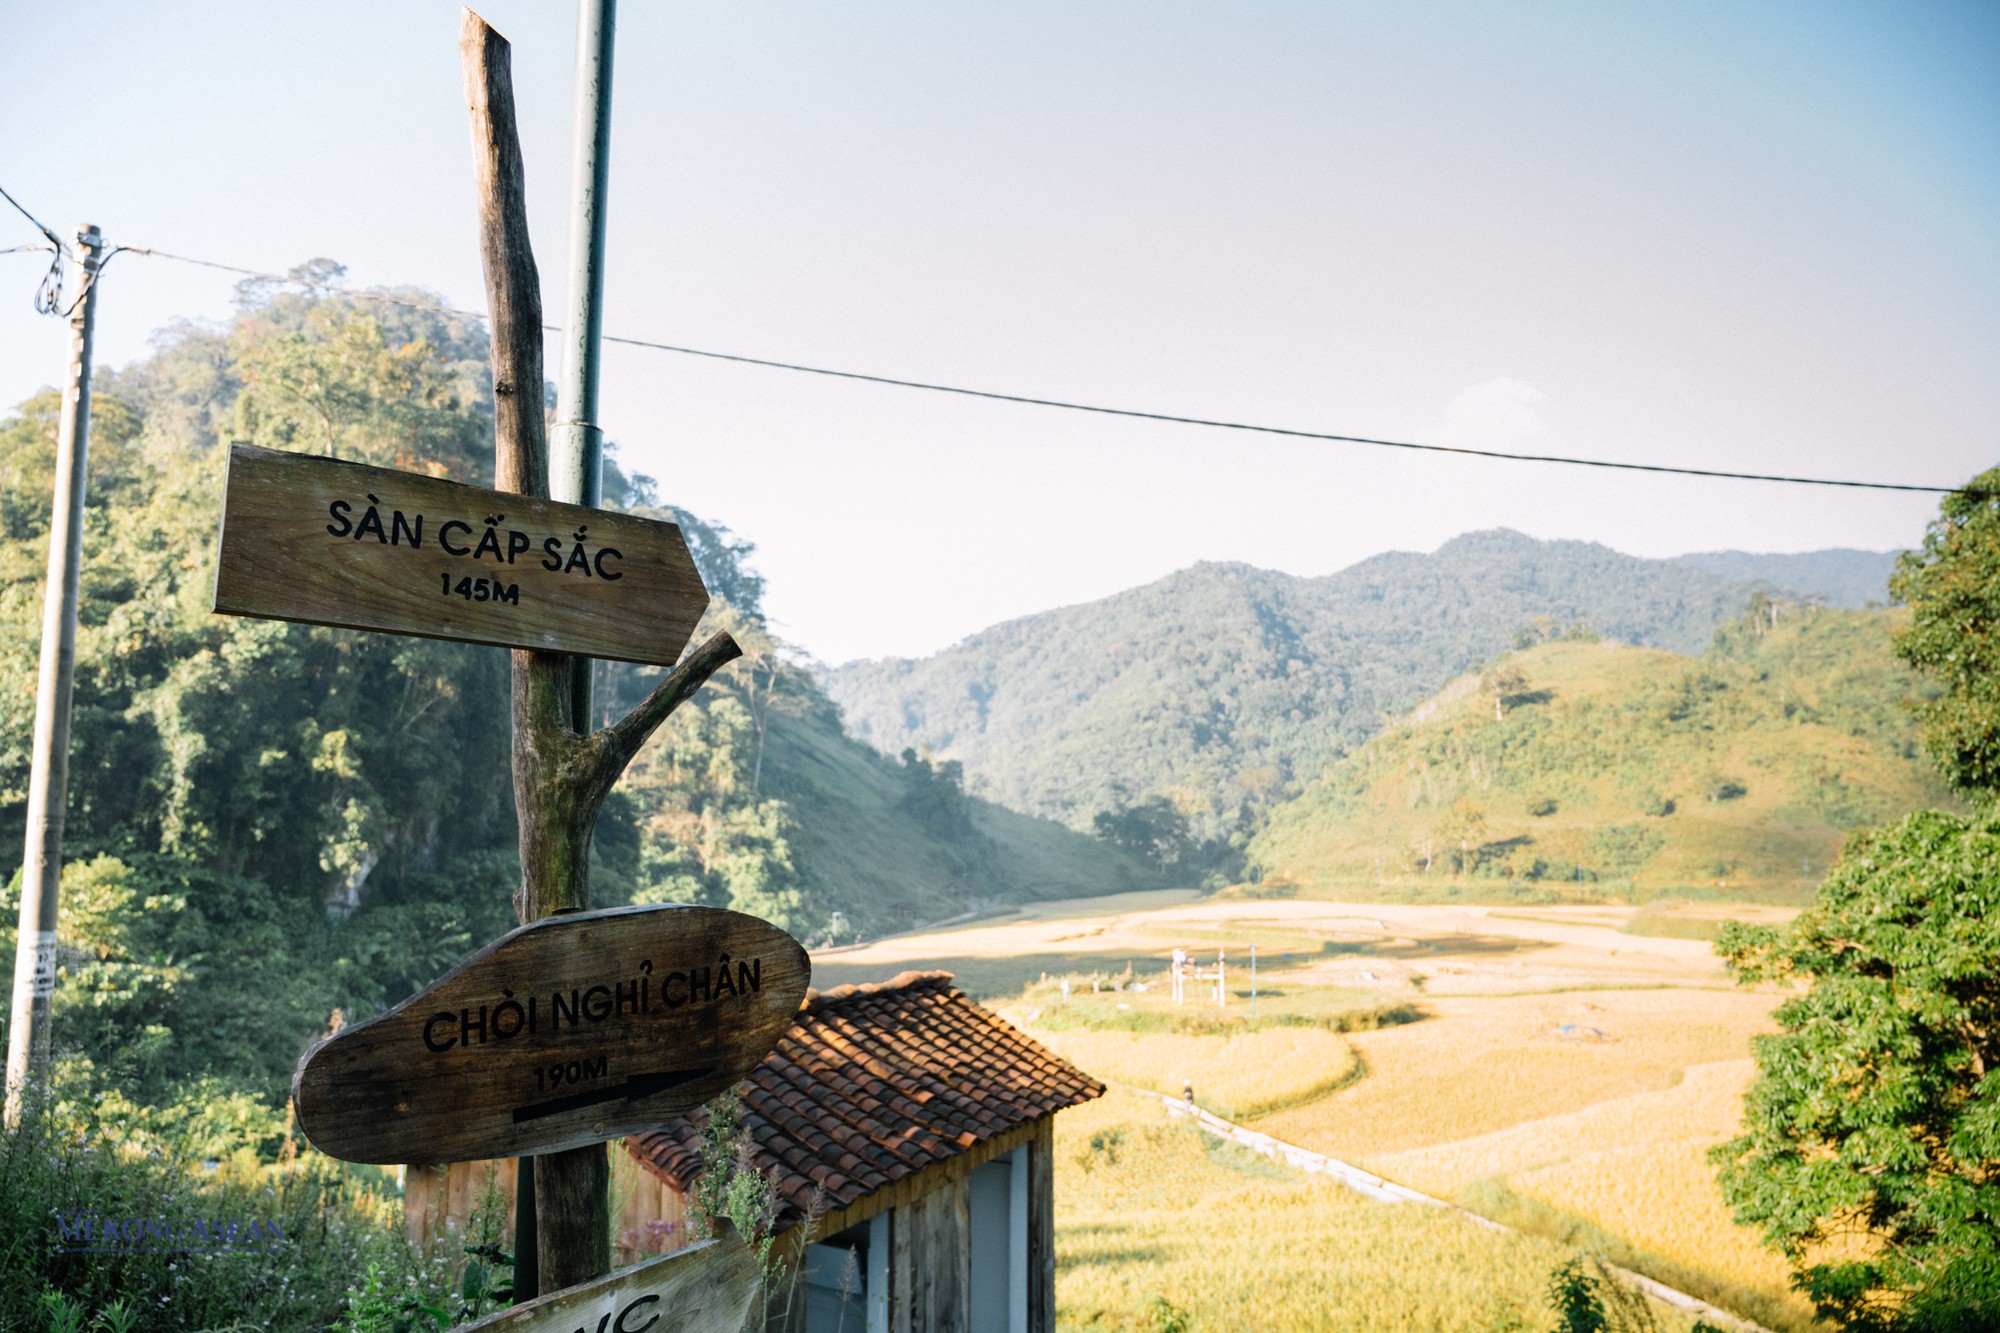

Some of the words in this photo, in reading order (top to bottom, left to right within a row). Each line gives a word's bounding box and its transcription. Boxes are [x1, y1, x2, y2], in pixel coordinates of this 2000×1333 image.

[326, 493, 423, 549] SÀN
[438, 513, 531, 565] CẤP
[541, 525, 623, 581] SẮC
[441, 572, 519, 606] 145M
[423, 989, 537, 1053] CHÒI
[552, 959, 653, 1030] NGHỈ
[661, 953, 761, 1009] CHÂN
[533, 1055, 608, 1092] 190M
